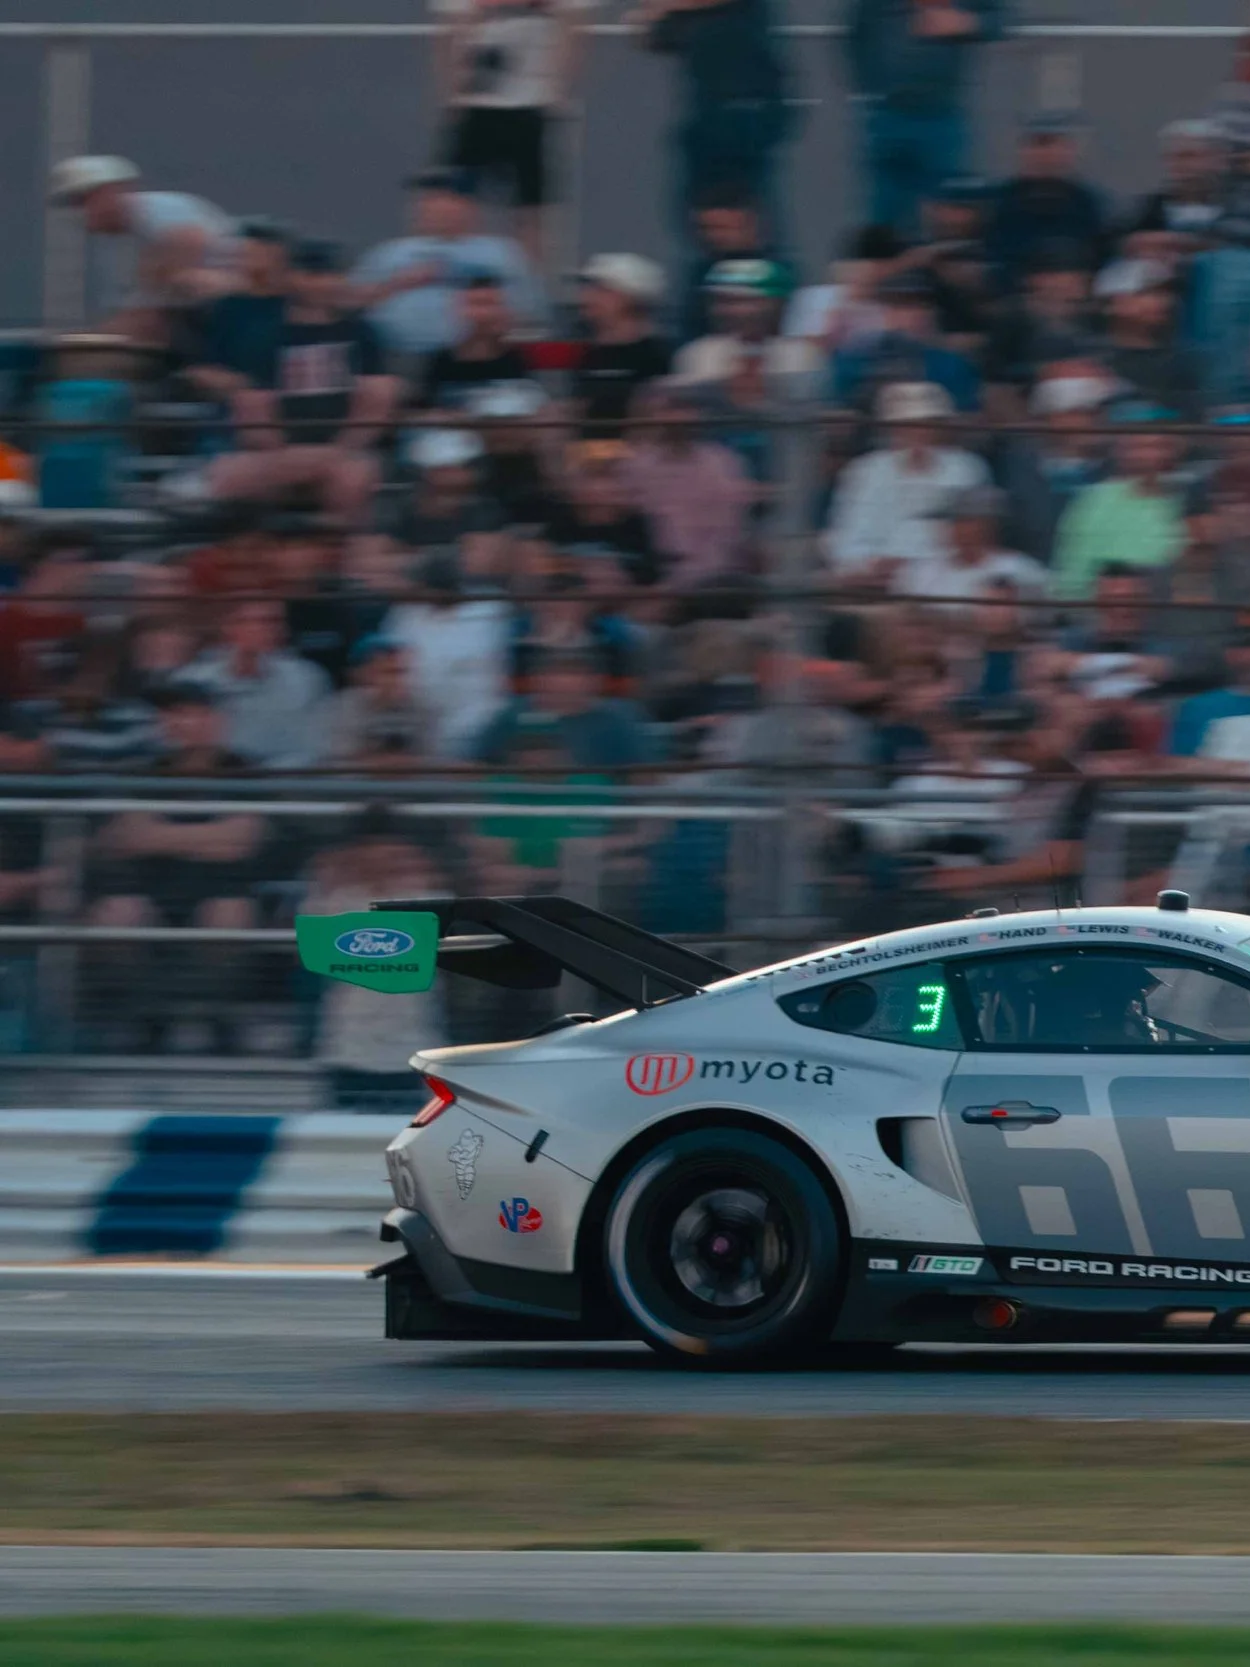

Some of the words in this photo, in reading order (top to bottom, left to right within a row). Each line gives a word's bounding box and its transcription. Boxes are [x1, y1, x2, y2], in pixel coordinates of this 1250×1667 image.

[999, 926, 1047, 940] HAND
[1077, 924, 1130, 934] LEWIS
[349, 932, 400, 953] Ford
[1157, 928, 1225, 953] WALKER
[329, 963, 420, 973] RACING
[912, 985, 946, 1033] 3
[700, 1059, 834, 1086] myota
[500, 1197, 529, 1233] VP
[1010, 1256, 1114, 1276] FORD
